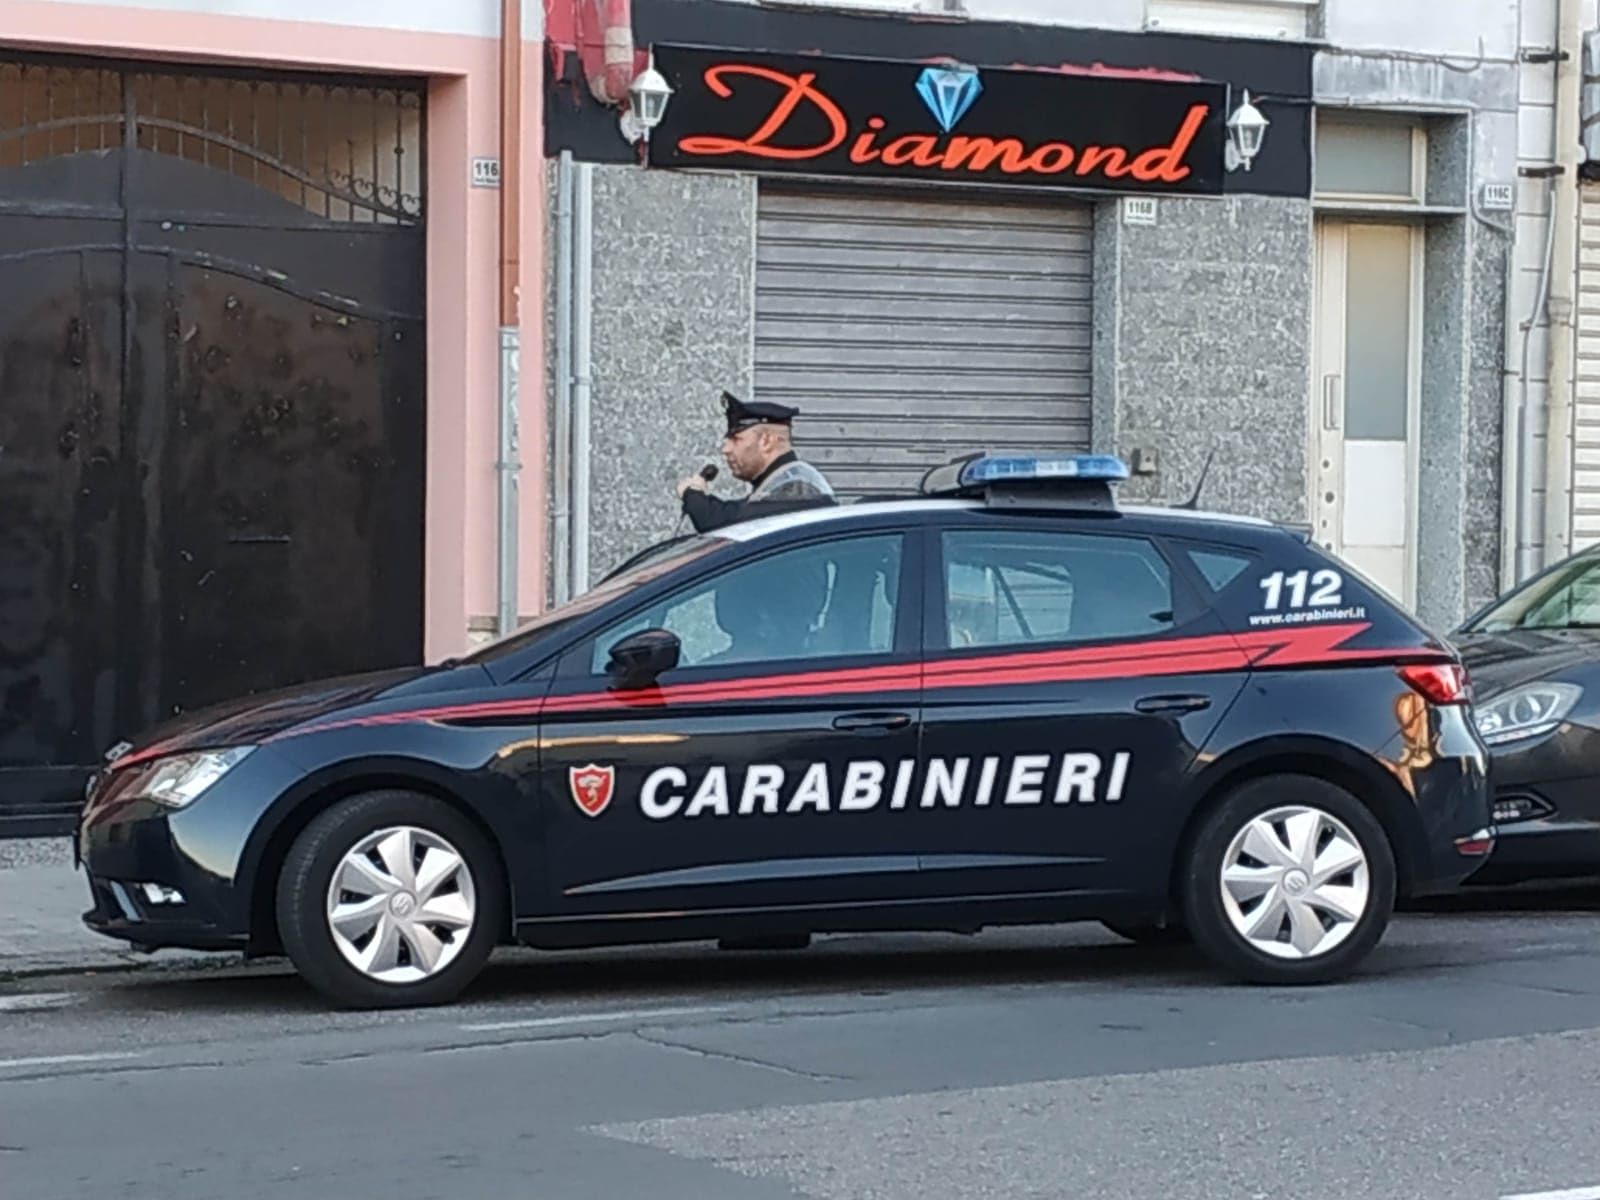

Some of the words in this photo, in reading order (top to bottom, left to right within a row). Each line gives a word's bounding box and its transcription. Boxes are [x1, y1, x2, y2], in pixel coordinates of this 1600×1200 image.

[679, 64, 1209, 183] Diamond
[1249, 607, 1366, 625] www.carabinieri.it
[1260, 569, 1343, 610] 112
[640, 752, 1130, 819] CARABINIERI
